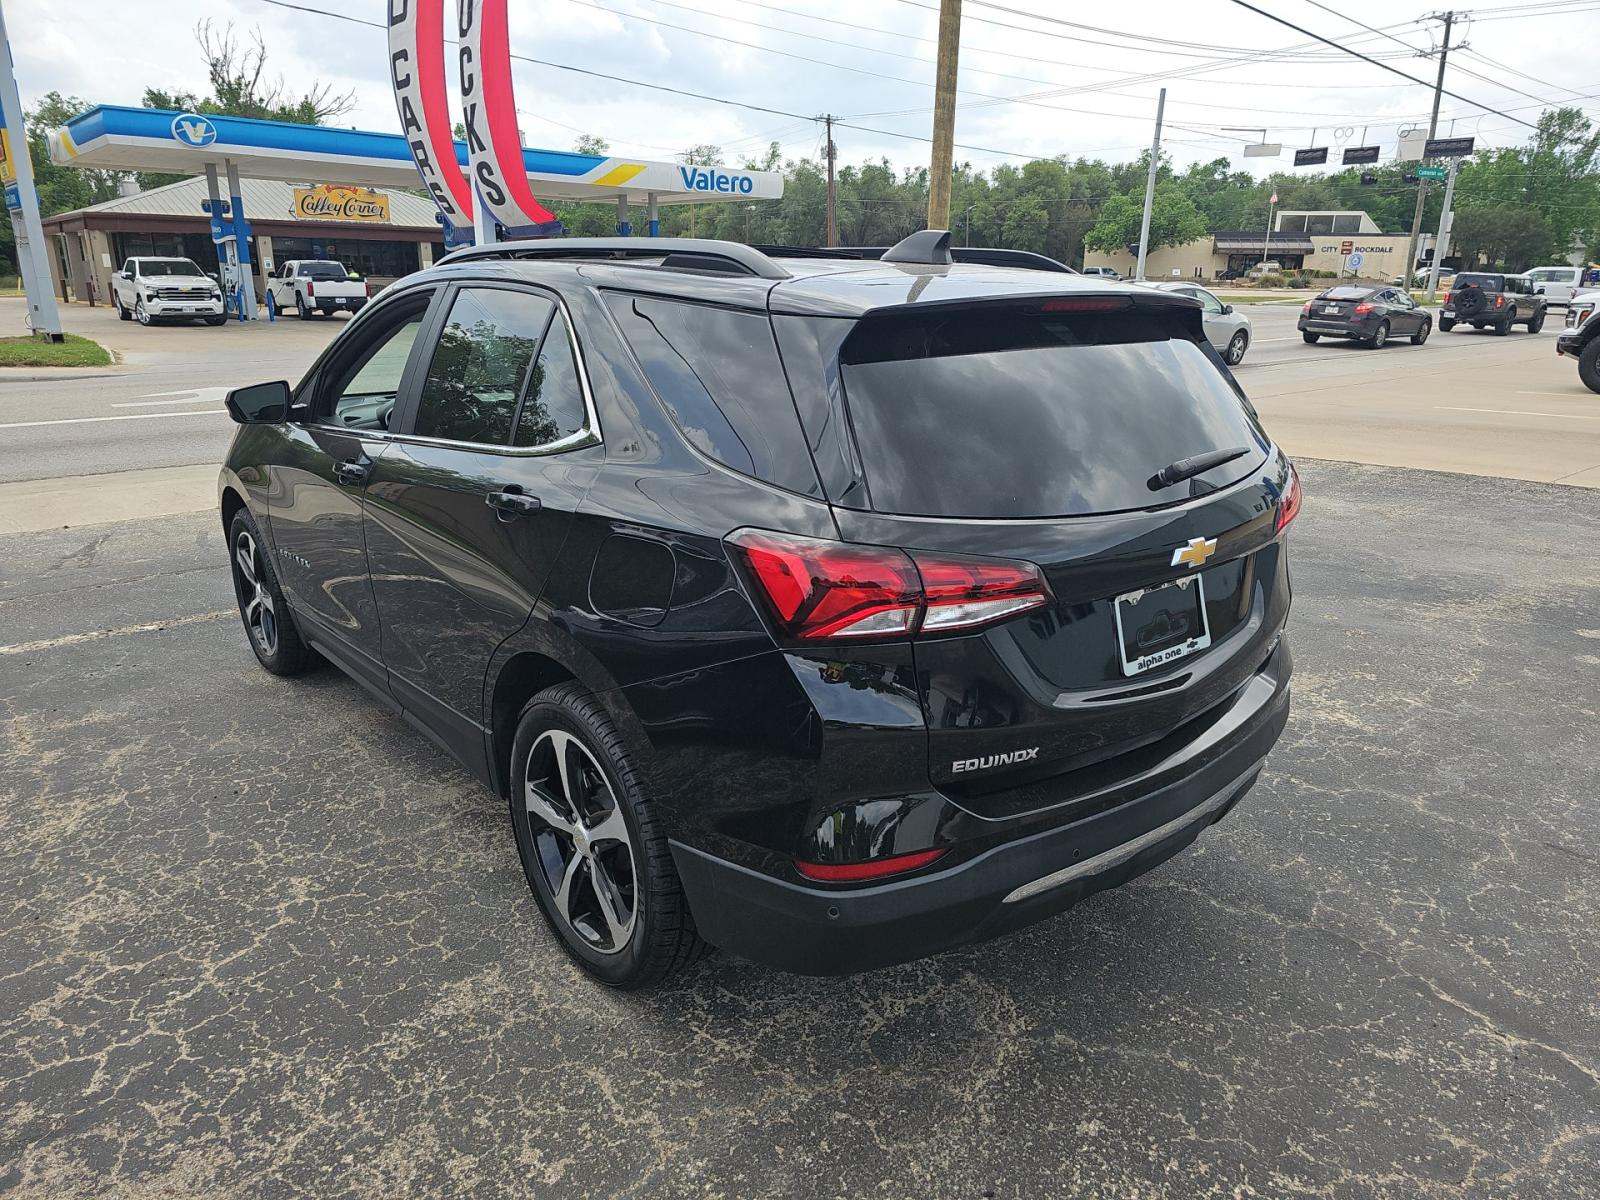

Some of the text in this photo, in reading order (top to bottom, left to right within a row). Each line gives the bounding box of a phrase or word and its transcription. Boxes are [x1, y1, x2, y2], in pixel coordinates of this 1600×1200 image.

[392, 48, 456, 215] CARS
[680, 166, 753, 194] Valero
[343, 197, 386, 219] Corner
[1137, 647, 1182, 671] alpha one
[951, 747, 1040, 773] EQUINOX
